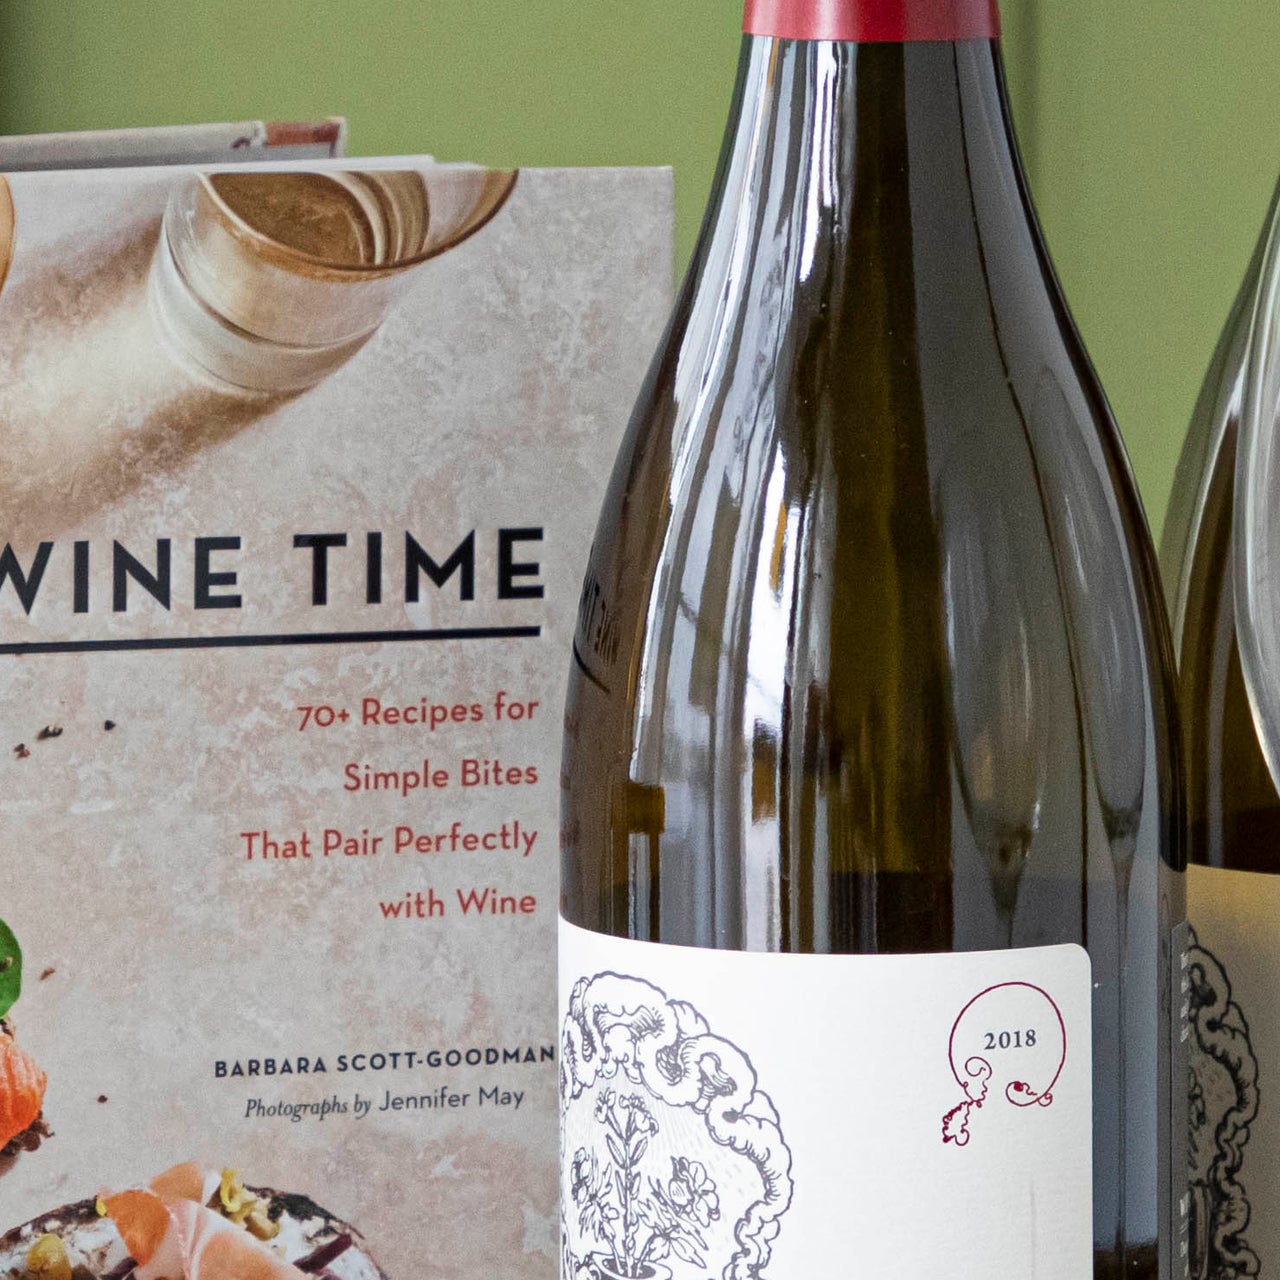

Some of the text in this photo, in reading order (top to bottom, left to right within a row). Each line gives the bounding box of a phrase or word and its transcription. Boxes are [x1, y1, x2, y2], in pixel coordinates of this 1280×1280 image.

[294, 527, 545, 607] TIME
[297, 691, 539, 732] 70+ Recipes for
[344, 759, 538, 797] Simple Bites
[240, 820, 538, 860] That Pair Perfectly
[379, 888, 537, 919] with Wine
[984, 1029, 1037, 1050] 2018
[215, 1045, 556, 1078] BARBARA SCOTT-GOODMAN
[244, 1086, 524, 1122] Photographs by Jennifer May
